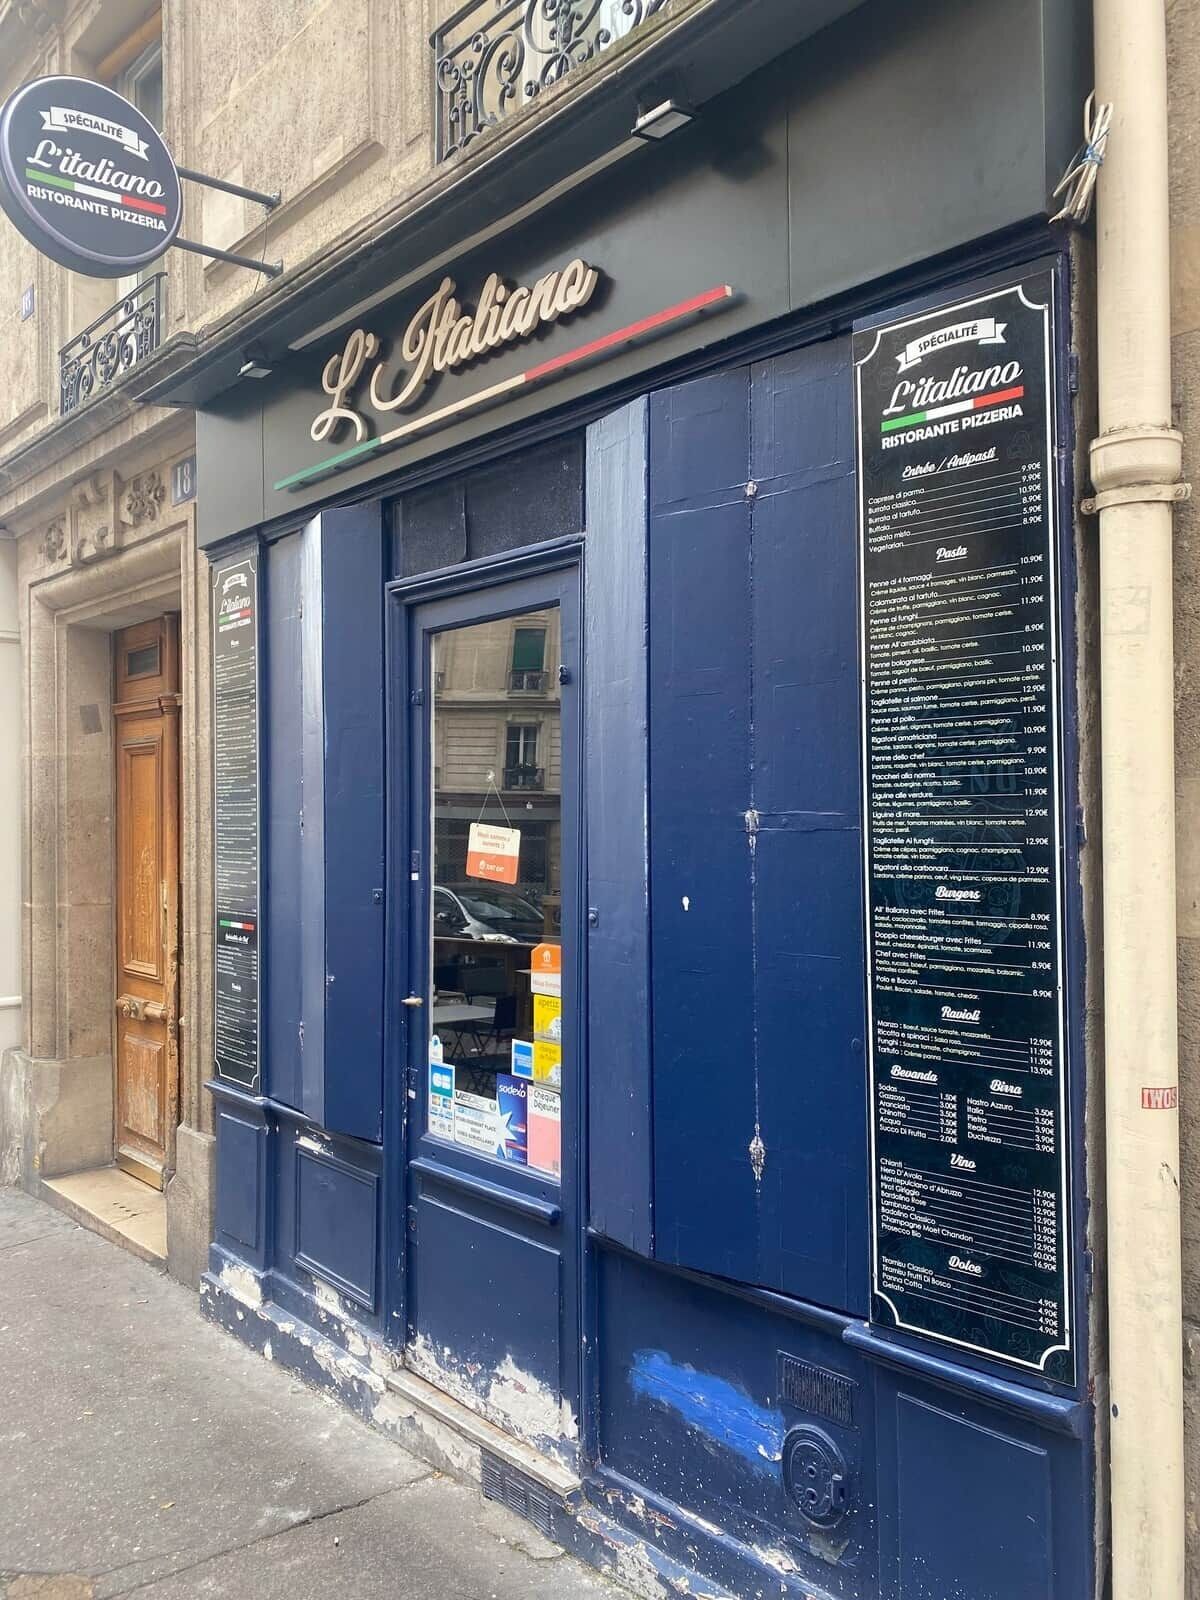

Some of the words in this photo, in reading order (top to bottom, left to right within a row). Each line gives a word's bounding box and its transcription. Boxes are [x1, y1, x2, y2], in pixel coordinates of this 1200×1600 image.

[64, 113, 123, 139] SPÉCIALITÉ
[27, 139, 165, 198] L'italiano
[27, 185, 109, 217] RISTORANTE
[112, 208, 167, 231] PIZZERIA
[370, 258, 599, 412] Italiano
[918, 323, 978, 352] SPÉCIALITÉ
[883, 361, 1023, 415] L'italiano
[881, 421, 959, 449] RISTORANTE
[962, 404, 1023, 428] PIZZERIA
[902, 459, 935, 478] Entrée
[947, 445, 996, 471] Antipasti
[1022, 461, 1041, 472] 9.90€
[177, 463, 190, 498] 18
[1022, 472, 1041, 482] 9.90€
[1019, 483, 1041, 494] 10.90€
[1022, 493, 1042, 504] 8.90€
[1022, 504, 1042, 514] 5.90€
[1022, 515, 1042, 525] 8.90€
[935, 543, 967, 560] Pasta
[1020, 554, 1043, 564] 10.90€
[1021, 575, 1043, 584] 11.90€
[1021, 595, 1043, 604] 11.90€
[1024, 623, 1044, 631] 8.90€
[1022, 643, 1045, 652] 10.90€
[1025, 663, 1045, 671] 8.90€
[1022, 684, 1045, 692] 12.90€
[1023, 705, 1046, 713] 11.90€
[935, 885, 980, 900] Burgers
[1028, 941, 1050, 949] 11.90€
[1031, 989, 1051, 997] 8.90€
[941, 1005, 980, 1021] Ravioli
[1029, 1038, 1052, 1047] 12.90€
[1029, 1047, 1052, 1056] 11.90€
[1030, 1057, 1052, 1066] 11.90€
[891, 1064, 937, 1082] Bevanda
[1030, 1066, 1052, 1075] 13.90€
[498, 1083, 526, 1098] sodexo
[989, 1078, 1022, 1095] Birra
[1034, 1108, 1054, 1117] 3.50€
[1034, 1116, 1054, 1126] 3.50€
[1034, 1125, 1054, 1135] 3.90€
[1034, 1134, 1054, 1144] 3.90€
[1035, 1143, 1054, 1153] 3.90€
[950, 1153, 976, 1170] Vino
[941, 1229, 973, 1243] Chandon
[1033, 1251, 1056, 1264] 60.00€
[948, 1254, 981, 1274] Dolce
[1033, 1260, 1056, 1273] 16.90€
